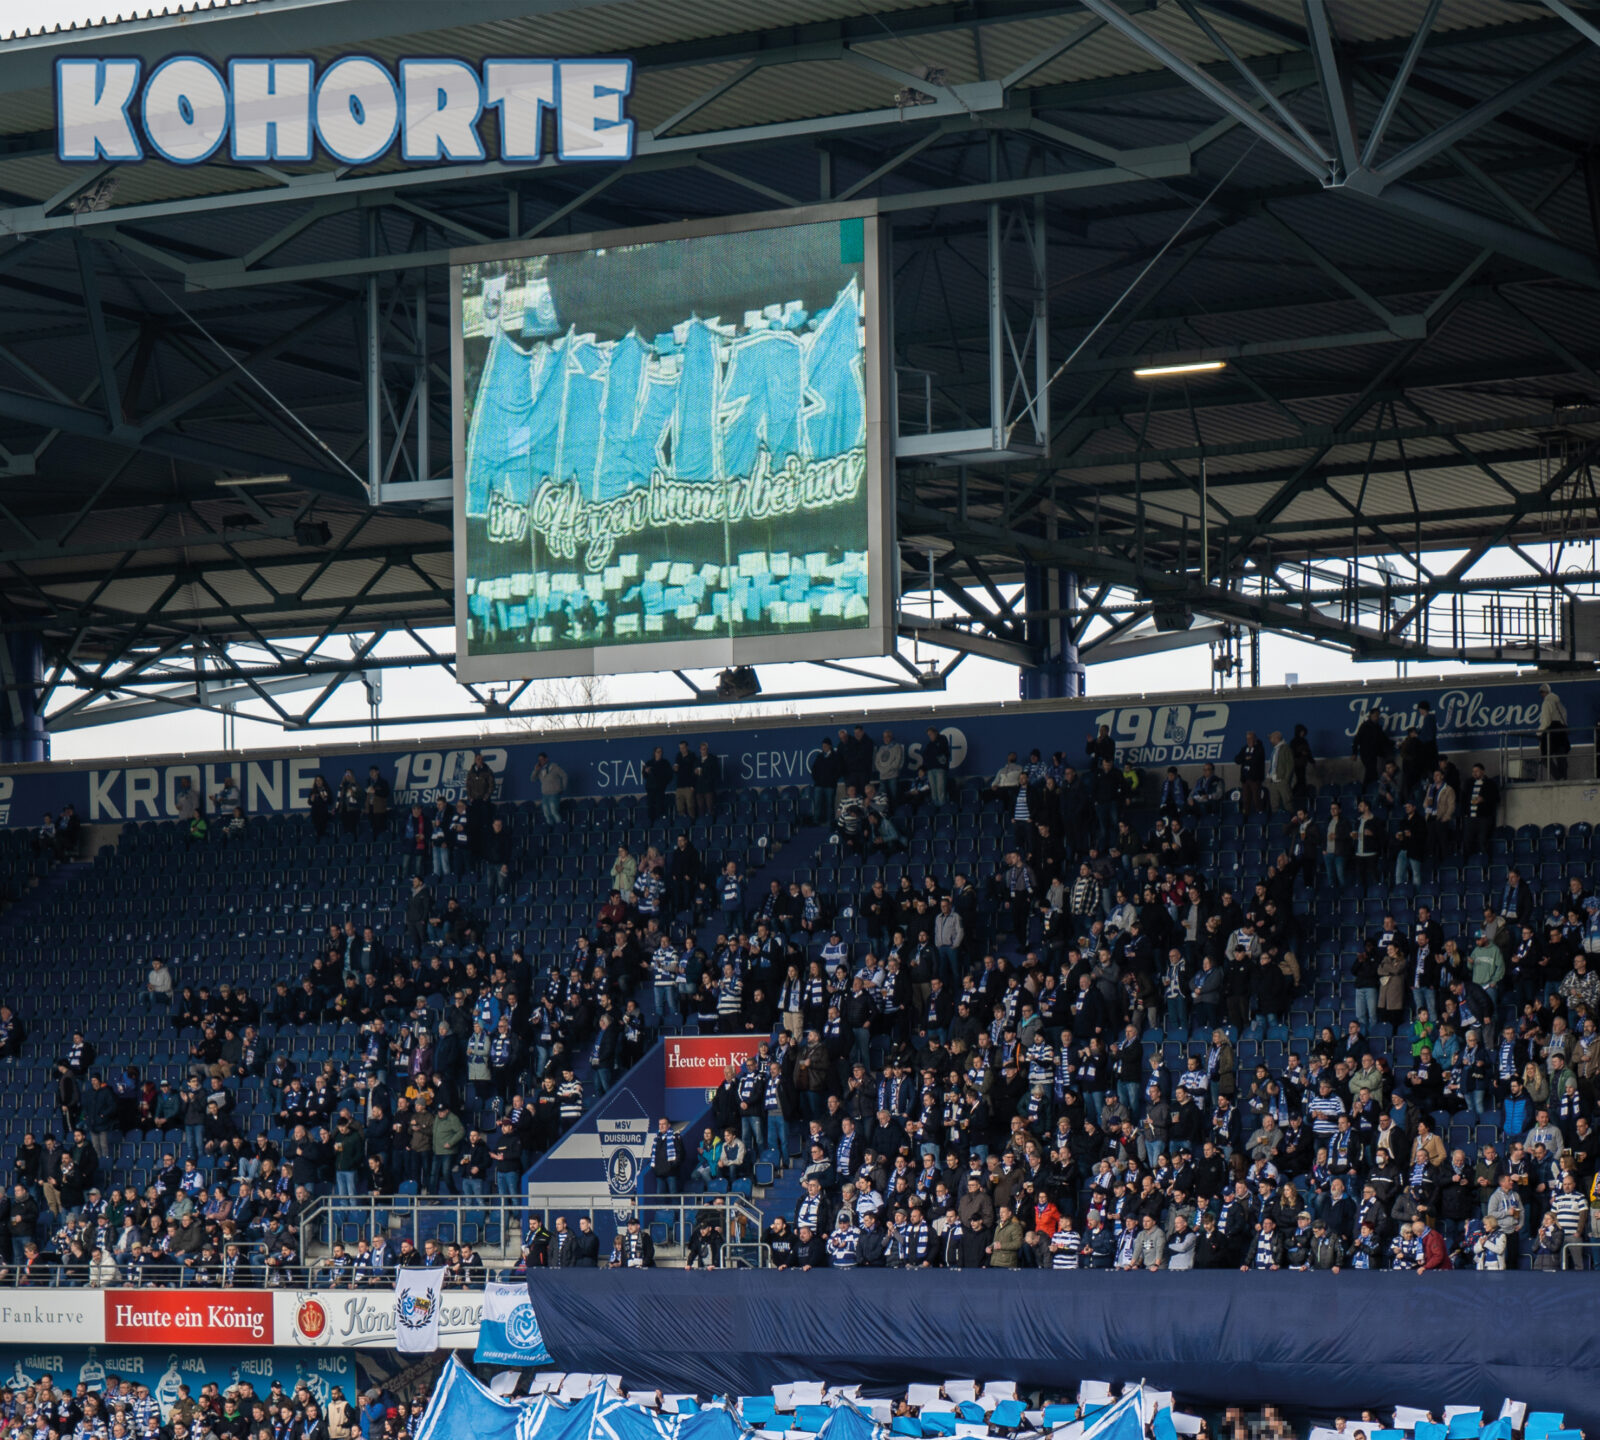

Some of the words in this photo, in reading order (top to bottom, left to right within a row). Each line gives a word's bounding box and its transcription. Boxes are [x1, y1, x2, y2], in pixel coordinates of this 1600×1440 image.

[1435, 690, 1542, 731] Pilsene
[1127, 747, 1167, 764] SIND
[1171, 743, 1223, 761] DABEI
[740, 749, 815, 779] SERVIC
[88, 757, 321, 821] KROHNE
[393, 789, 420, 805] WIR
[668, 1053, 706, 1068] Heute
[708, 1053, 726, 1067] ein
[614, 1120, 632, 1130] MSV
[604, 1133, 641, 1144] DUISBURG
[2, 1306, 85, 1324] Fankurve
[115, 1304, 172, 1328] Heute
[174, 1306, 203, 1328] ein
[208, 1305, 265, 1338] König
[340, 1296, 398, 1337] Köni
[25, 1354, 64, 1374] KRÄMER
[105, 1356, 145, 1375] SELIGER
[181, 1357, 207, 1375] JARA
[318, 1355, 347, 1375] BAJIC
